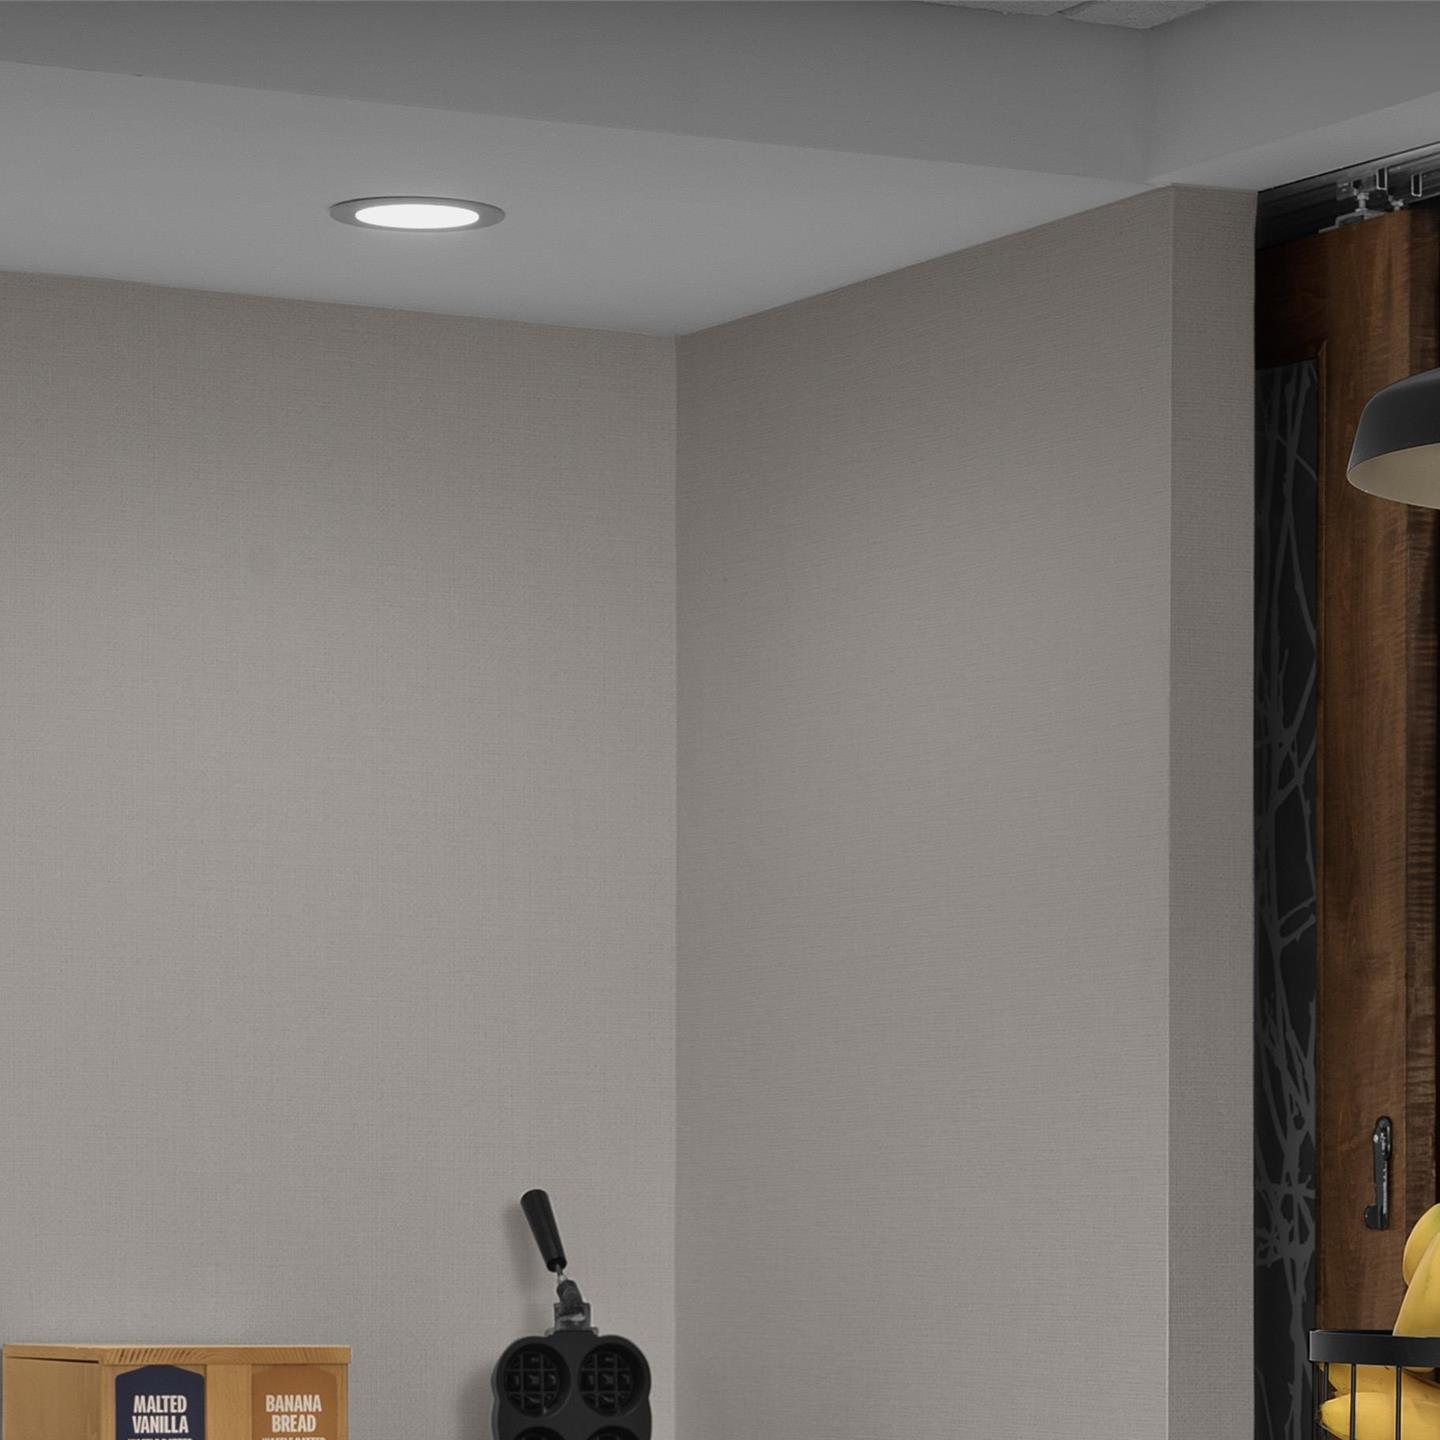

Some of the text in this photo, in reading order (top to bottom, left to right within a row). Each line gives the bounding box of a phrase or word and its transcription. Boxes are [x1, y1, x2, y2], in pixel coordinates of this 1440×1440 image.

[133, 1394, 188, 1414] MALTED
[265, 1393, 323, 1413] BANANA
[131, 1415, 190, 1434] VANILLA
[271, 1413, 317, 1433] BREAD
